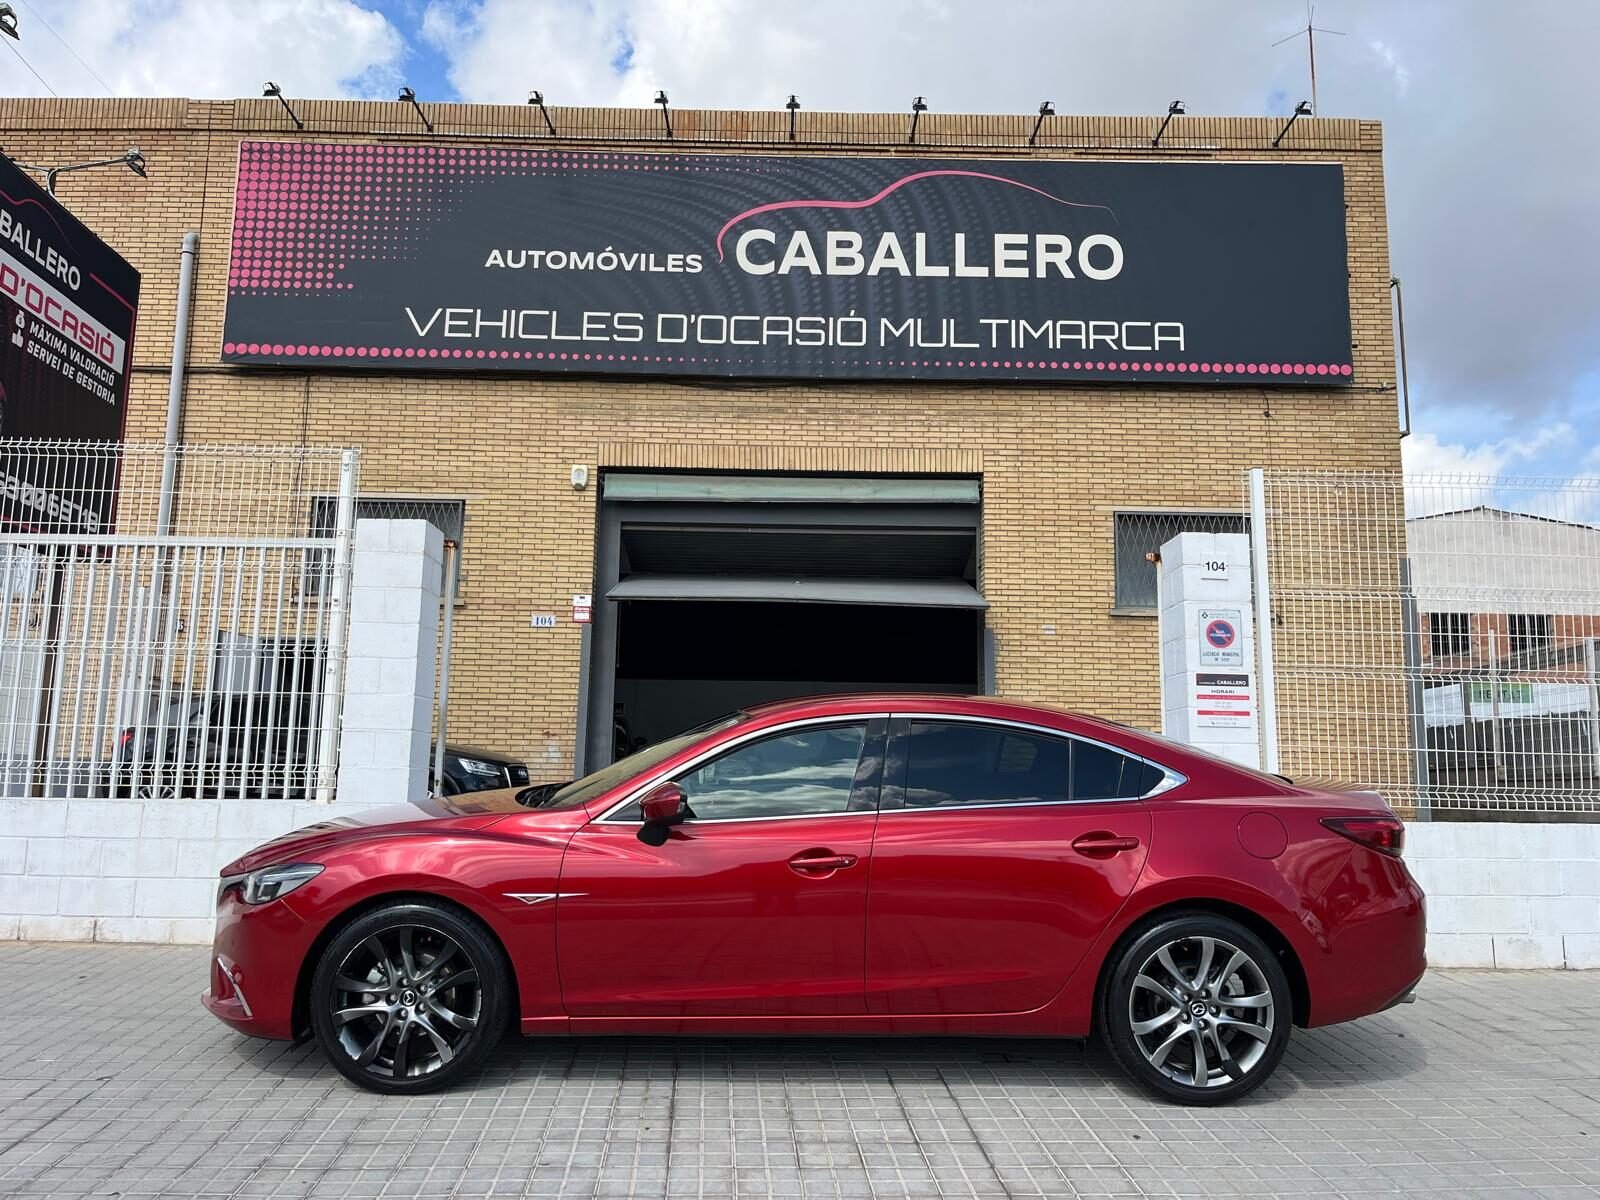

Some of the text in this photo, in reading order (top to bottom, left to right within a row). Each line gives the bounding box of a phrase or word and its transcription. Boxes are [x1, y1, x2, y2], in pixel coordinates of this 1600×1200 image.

[484, 228, 1124, 281] AUTOMÓVILES CABALLERO
[0, 263, 115, 364] D'OCASIÓ
[405, 307, 1185, 351] VEHICLES D'OCASIÓ MULTIMARCA
[27, 340, 115, 406] SERVEI DE GESTORIA
[70, 347, 115, 387] VALORACIÓ
[1205, 561, 1226, 572] 104
[535, 616, 553, 626] 104
